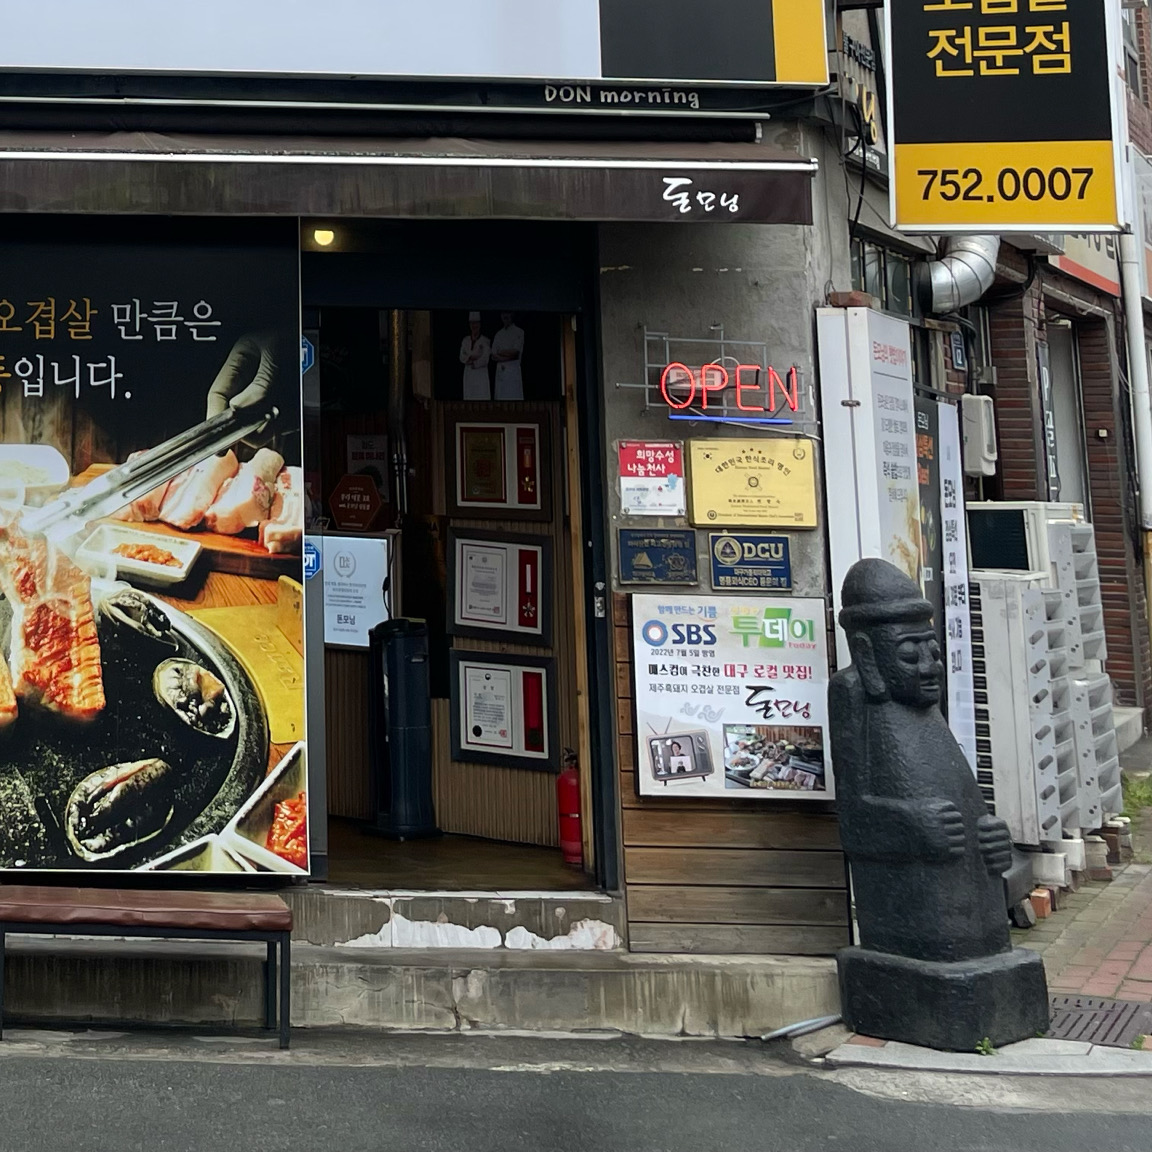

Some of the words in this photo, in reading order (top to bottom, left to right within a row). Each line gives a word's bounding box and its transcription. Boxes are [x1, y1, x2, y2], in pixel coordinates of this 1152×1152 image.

[926, 23, 1072, 78] 전문점
[544, 85, 591, 102] DON
[600, 88, 700, 109] morning
[916, 166, 1094, 205] 752.0007
[110, 299, 221, 341] 만큼은
[660, 361, 798, 412] OPEN
[636, 449, 675, 463] 희망수성
[627, 463, 666, 476] 나눔천사
[742, 542, 784, 558] DCU
[672, 623, 717, 645] SBS
[728, 614, 816, 648] 투데이
[650, 648, 675, 657] 2022년
[691, 664, 720, 678] 극찬한
[723, 663, 748, 679] 대구
[753, 664, 778, 679] 로컬
[782, 665, 812, 680] 맛집!
[690, 684, 714, 695] 오겹살
[717, 684, 741, 695] 전문점
